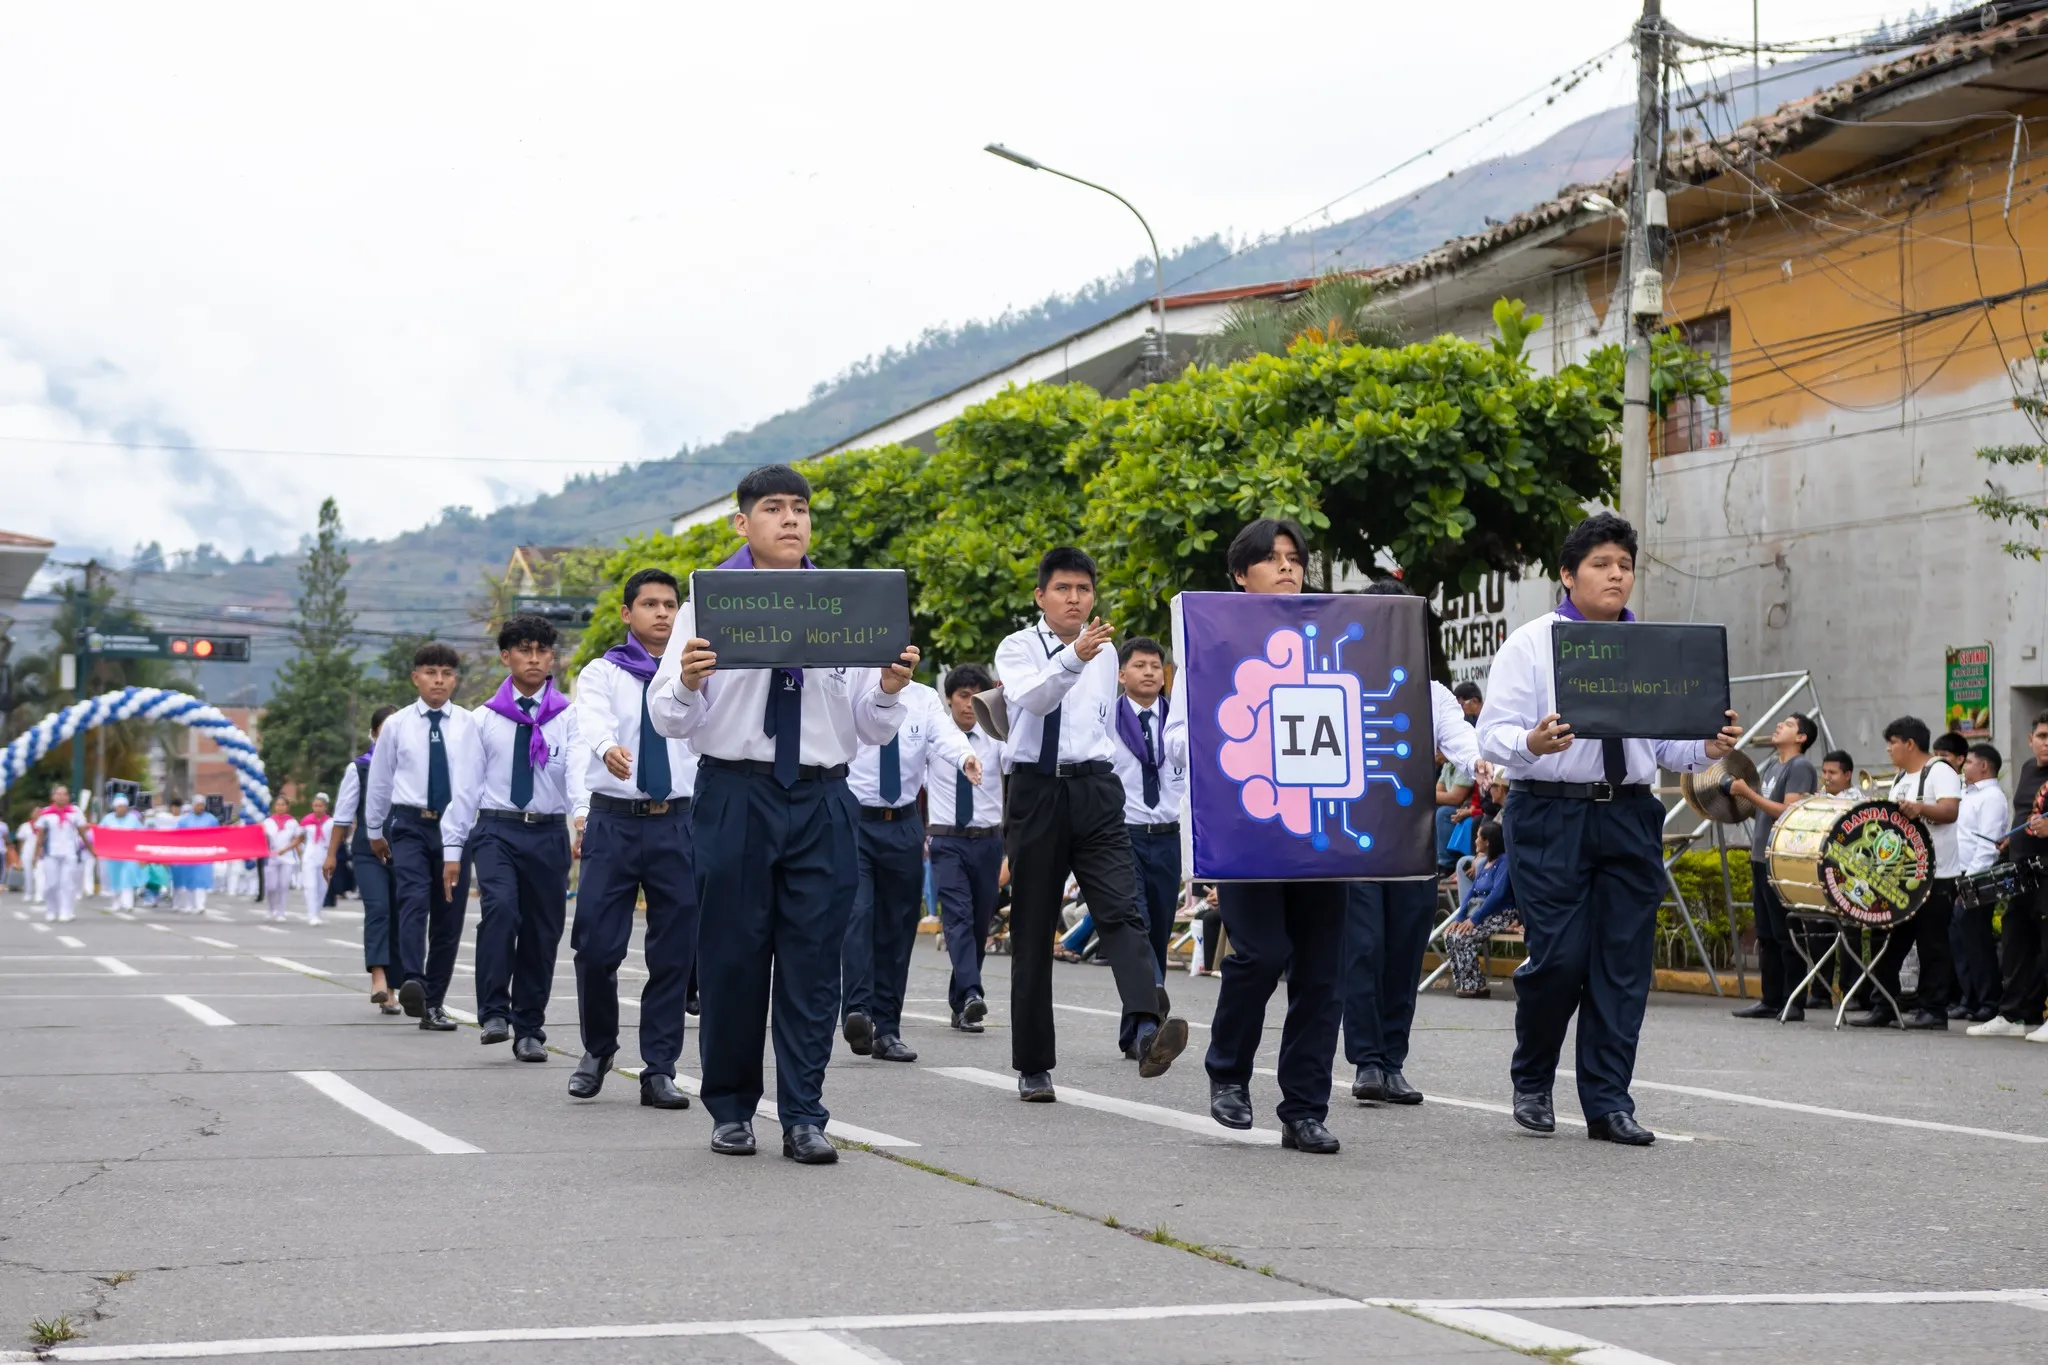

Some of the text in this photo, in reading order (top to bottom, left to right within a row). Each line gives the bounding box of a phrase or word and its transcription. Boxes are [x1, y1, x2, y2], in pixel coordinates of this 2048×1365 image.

[706, 591, 842, 615] Console.log
[1960, 648, 1987, 665] SE VENDE
[1461, 667, 1469, 680] LA
[1280, 715, 1342, 756] IA
[1842, 808, 1927, 880] BANDA ORQUESTA
